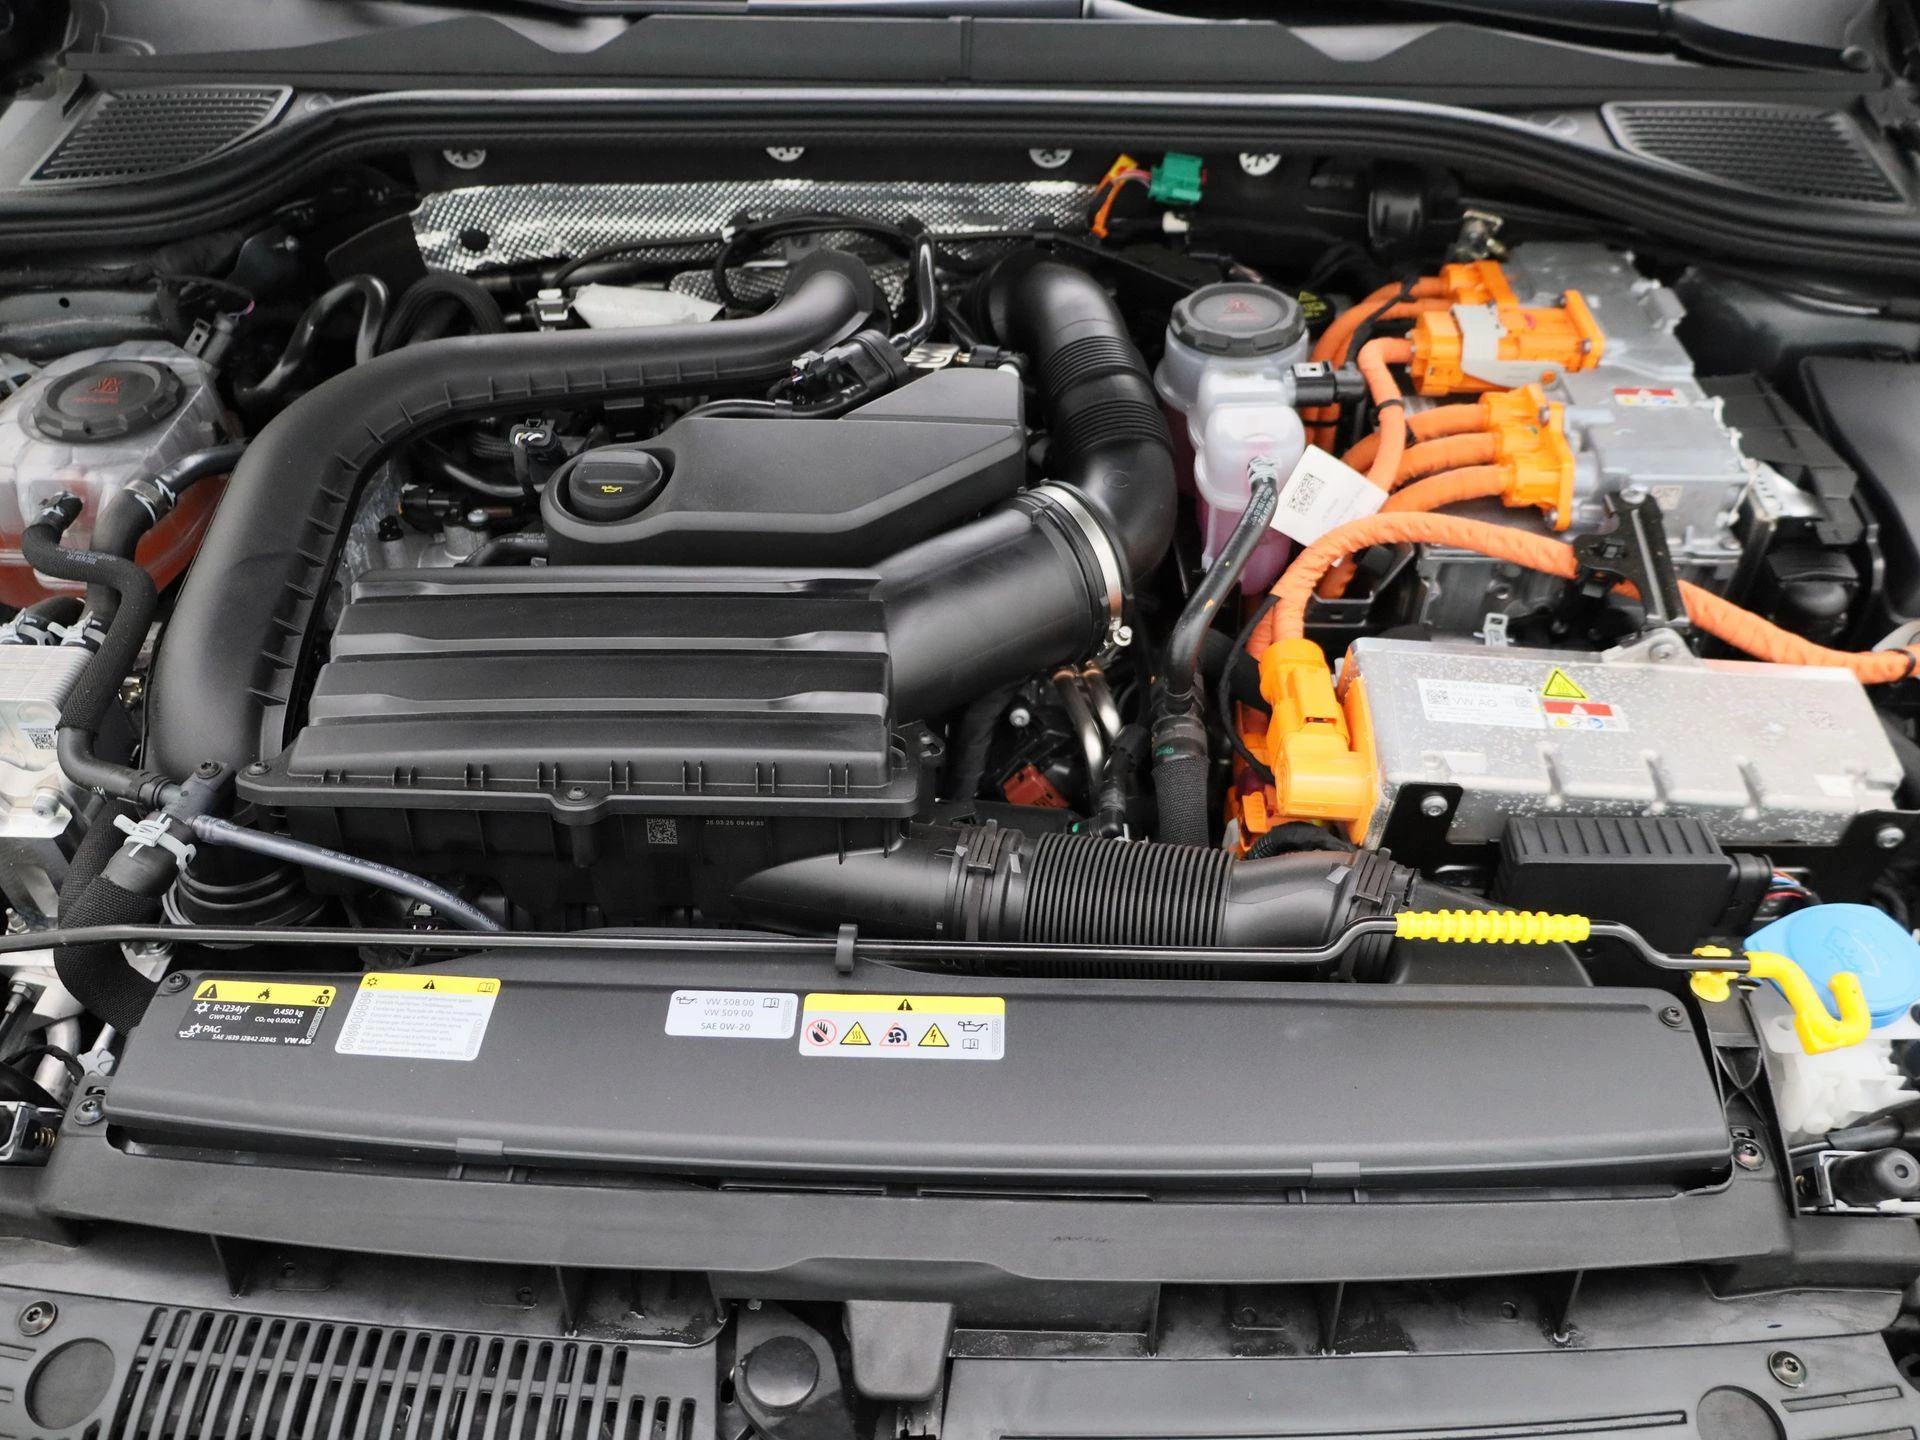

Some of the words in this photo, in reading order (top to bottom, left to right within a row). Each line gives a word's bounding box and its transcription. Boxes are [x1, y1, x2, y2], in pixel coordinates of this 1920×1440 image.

[723, 998, 741, 1006] 508
[742, 999, 755, 1007] 00
[213, 1004, 250, 1014] R-1234yf
[273, 1007, 295, 1016] 0.450
[295, 1009, 305, 1018] kg
[721, 1009, 740, 1017] 509
[202, 1025, 222, 1034] PAG
[700, 1022, 718, 1030] SAE
[719, 1022, 751, 1031] 0W-20
